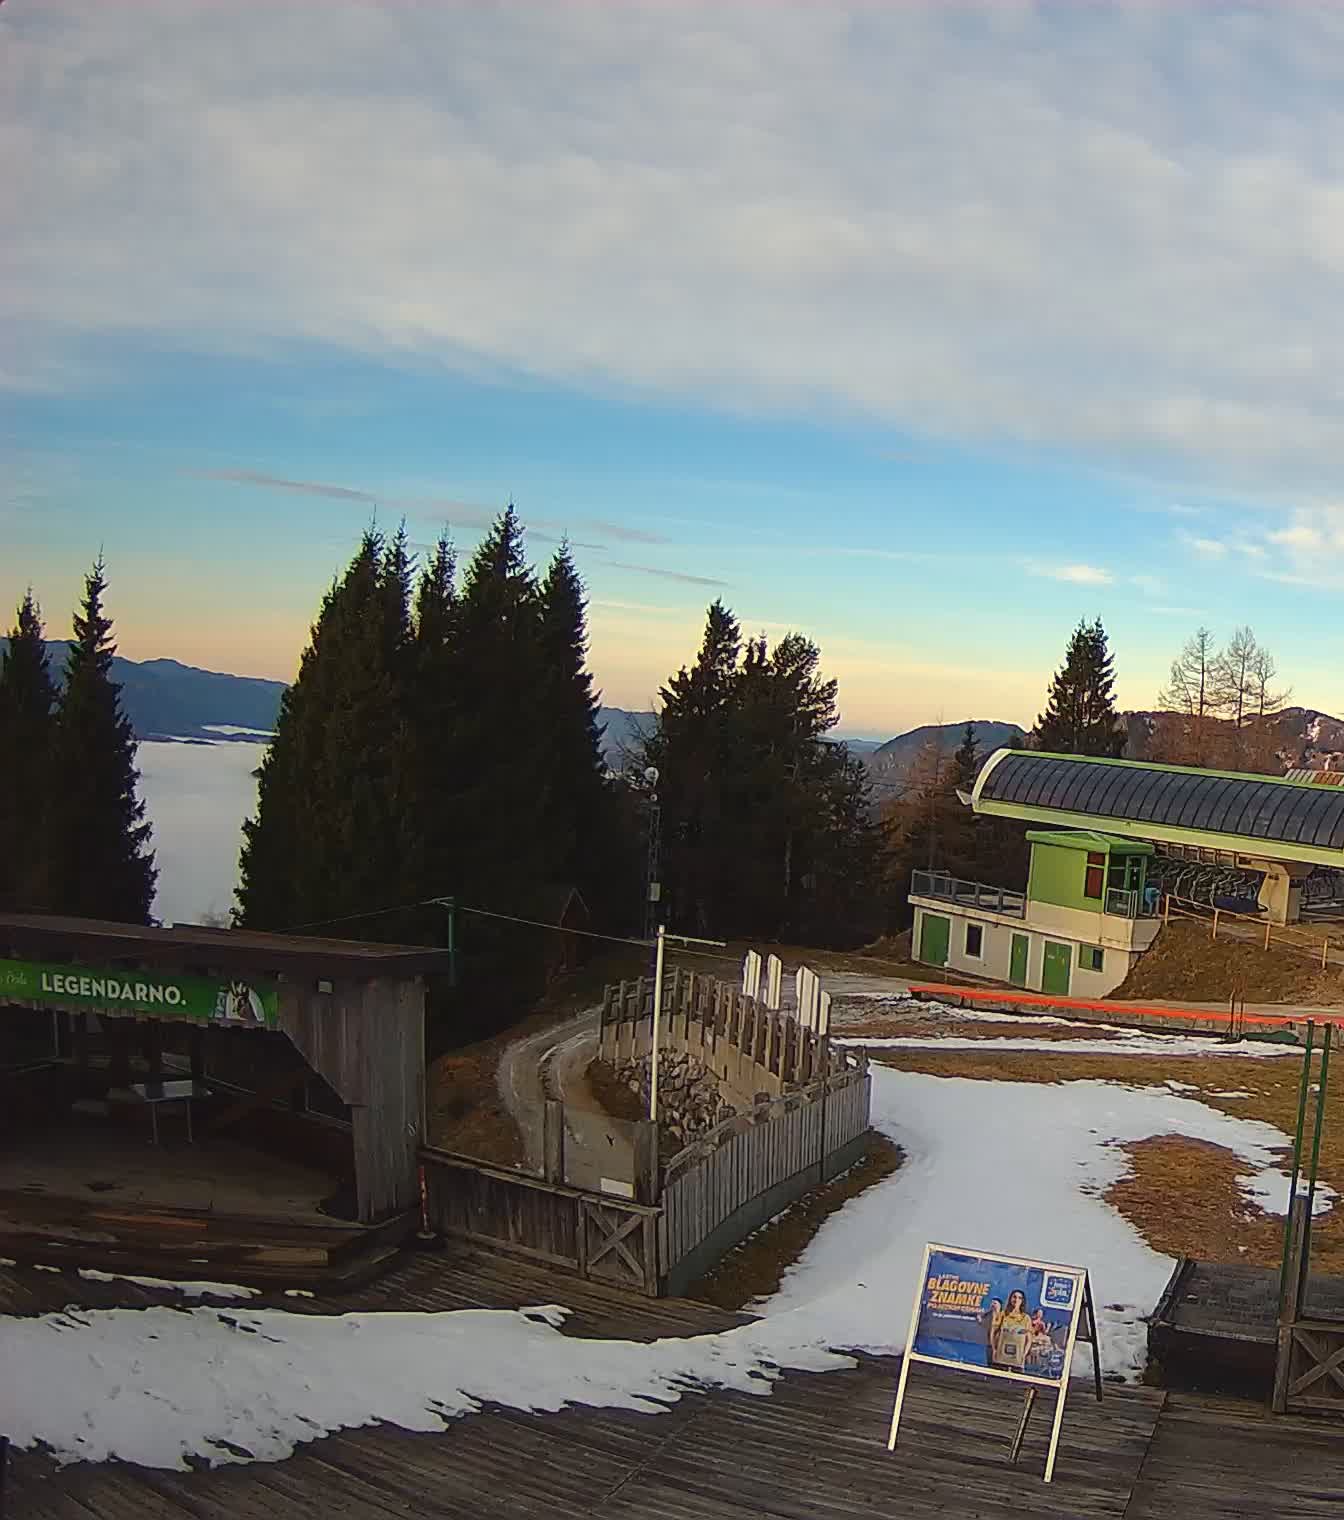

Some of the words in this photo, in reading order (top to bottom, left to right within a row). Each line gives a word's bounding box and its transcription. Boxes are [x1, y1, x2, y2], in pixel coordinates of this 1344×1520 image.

[41, 972, 187, 1006] LEGENDARNO.
[927, 1277, 991, 1296] BLAGOVNE
[929, 1290, 983, 1307] ZNAMKE
